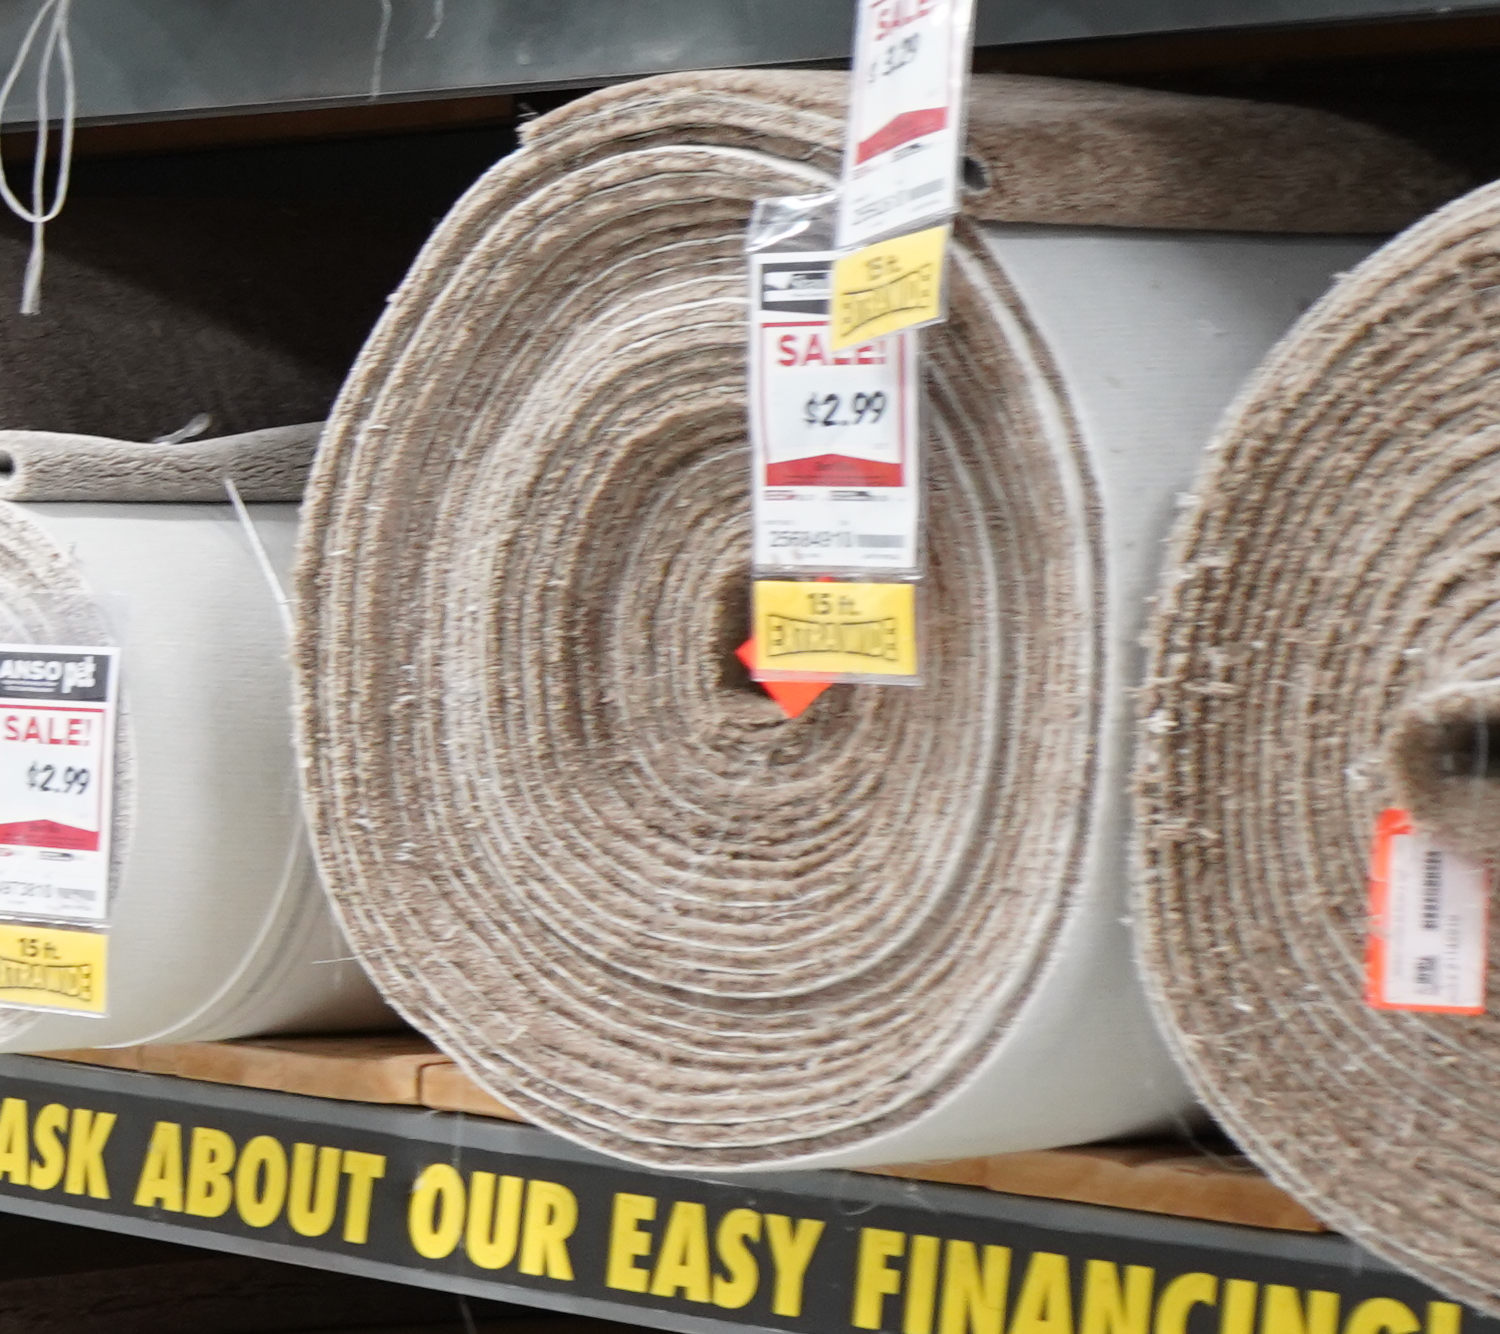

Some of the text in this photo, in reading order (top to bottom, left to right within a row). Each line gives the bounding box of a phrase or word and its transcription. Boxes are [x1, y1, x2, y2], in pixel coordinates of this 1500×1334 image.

[804, 390, 888, 428] $2.99
[807, 592, 830, 615] 15
[4, 716, 91, 746] SALE!
[27, 760, 90, 795] $2.99
[18, 937, 39, 958] 15
[134, 1122, 386, 1244] ABOUT
[409, 1163, 578, 1281] OUR
[606, 1192, 825, 1317] EASY
